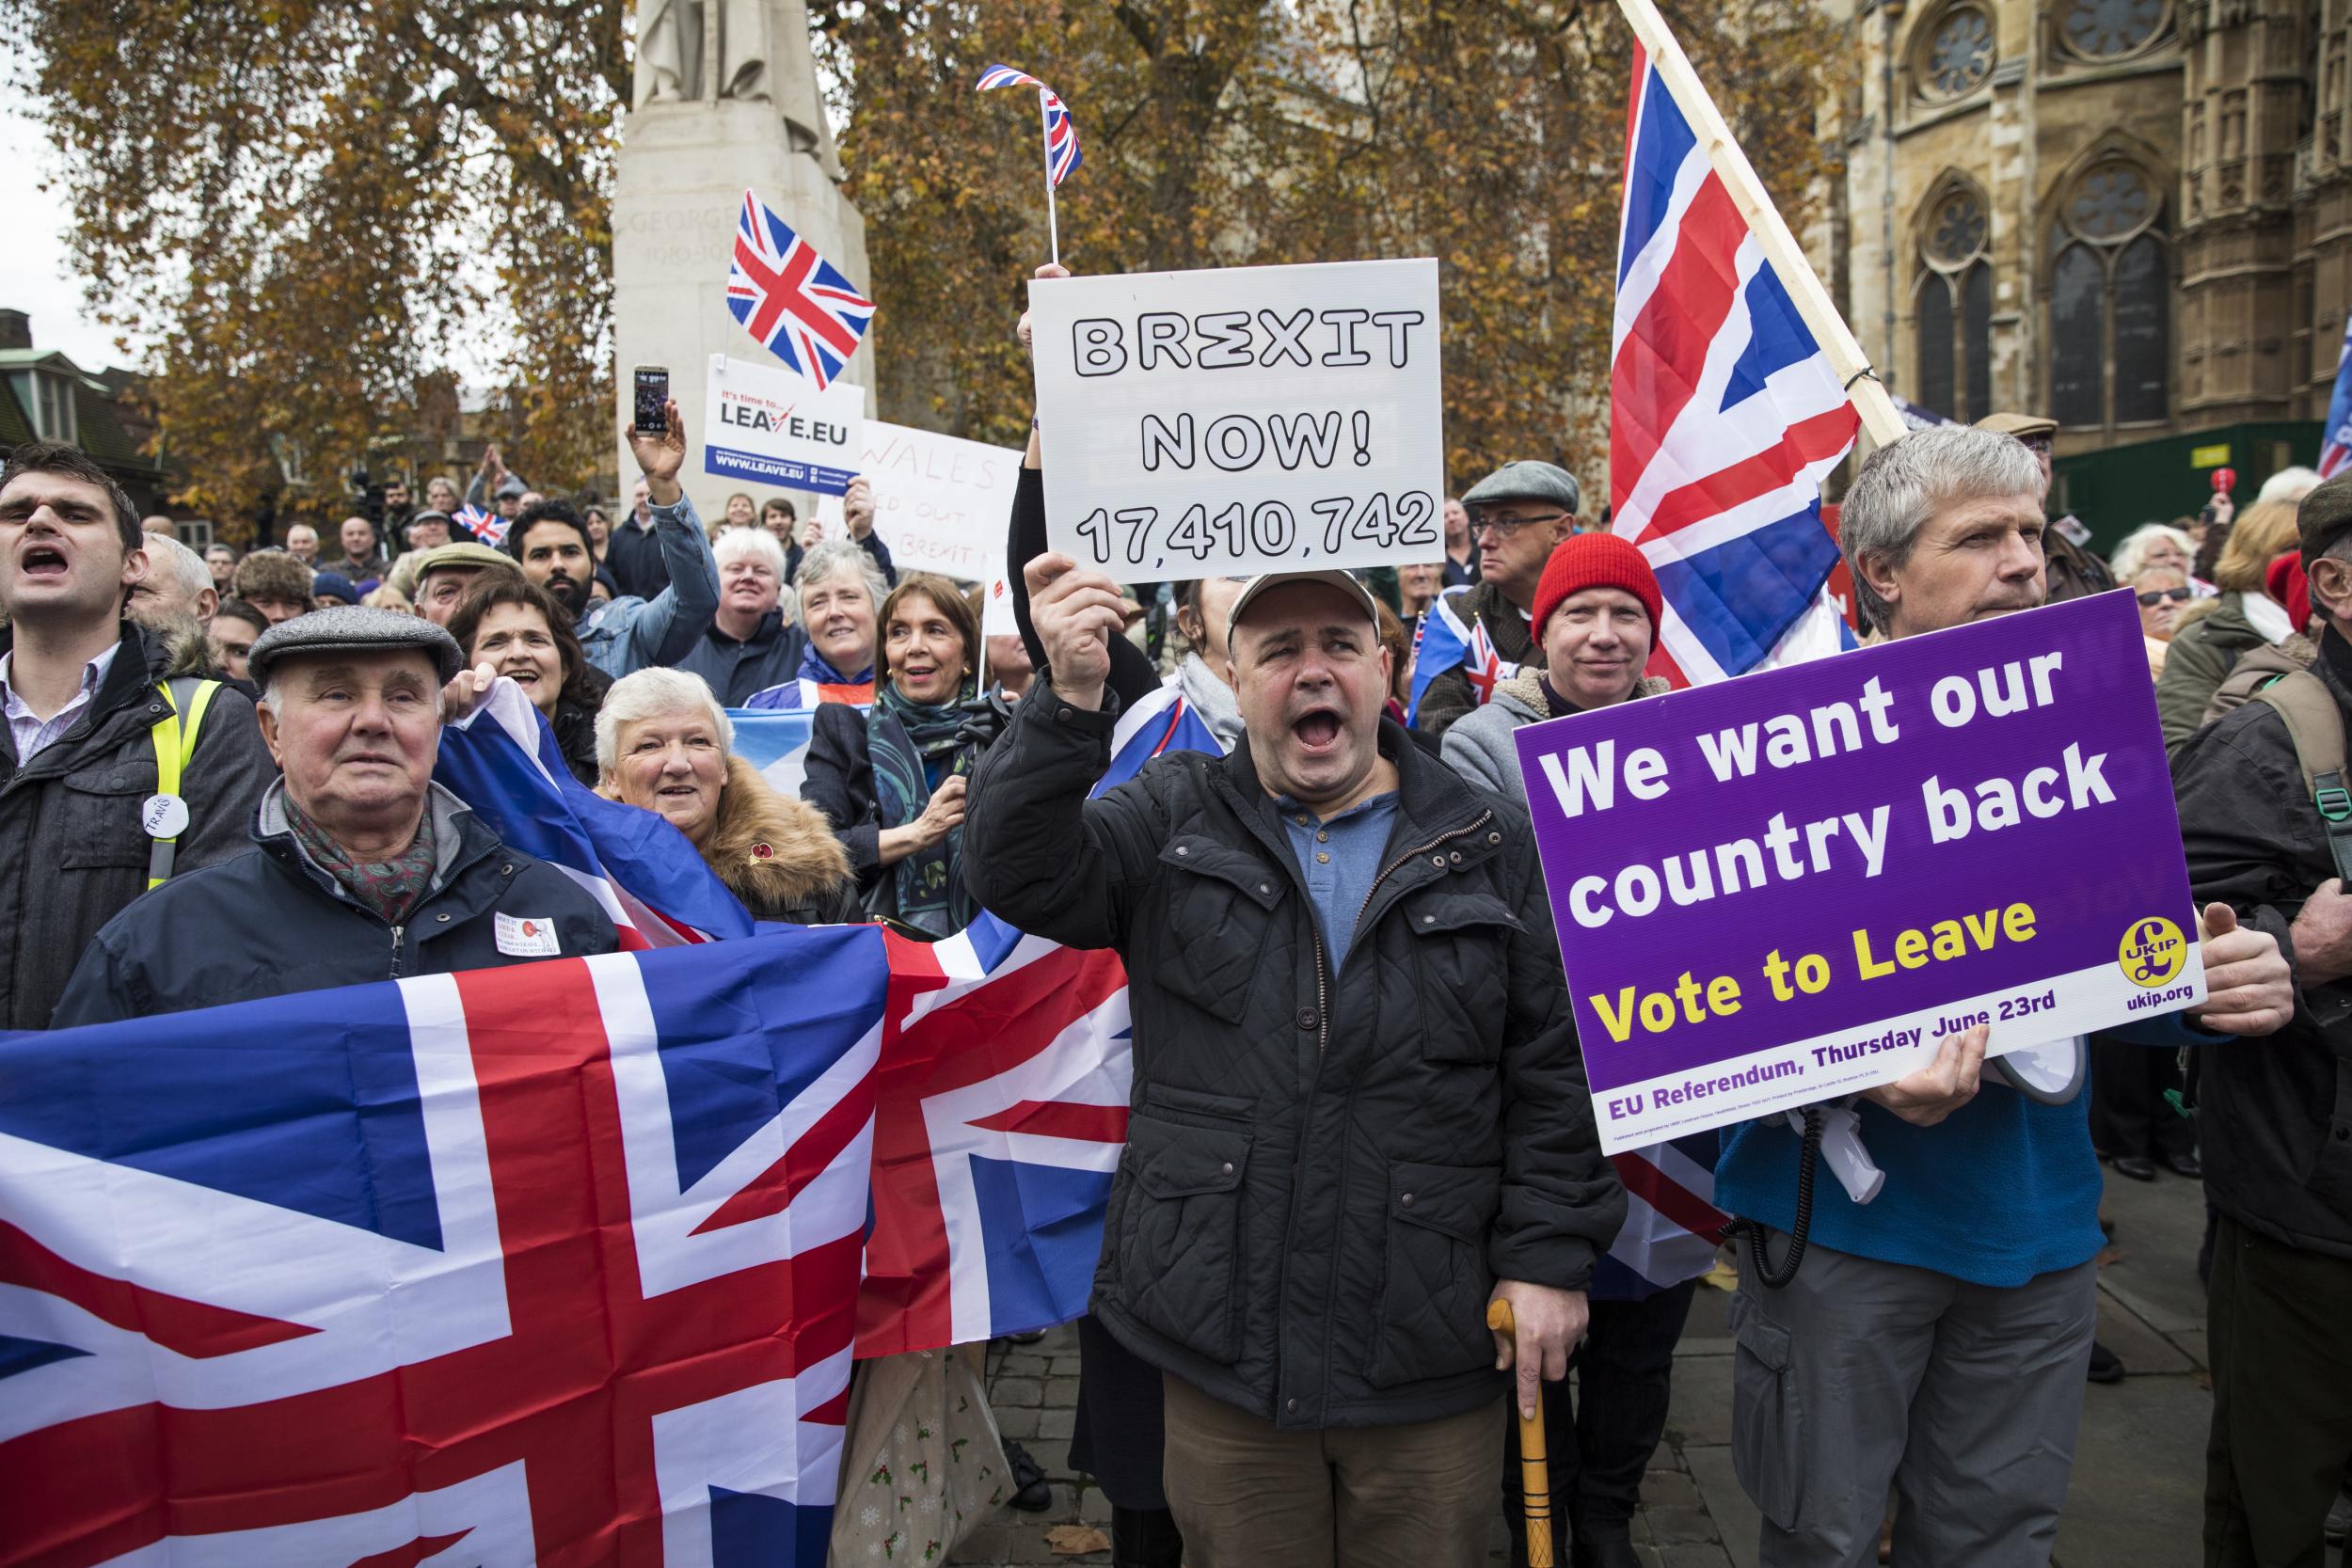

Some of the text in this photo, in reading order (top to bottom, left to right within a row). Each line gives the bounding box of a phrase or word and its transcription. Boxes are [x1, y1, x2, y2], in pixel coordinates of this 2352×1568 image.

[1072, 308, 1425, 378] BREXIT
[722, 389, 738, 401] It's
[740, 394, 763, 405] time
[715, 454, 804, 480] WWW.LEAVE.EU
[860, 437, 996, 490] WALES
[1140, 409, 1372, 472] NOW!
[1075, 490, 1438, 569] 17,410,742
[1538, 650, 2064, 819] We want our
[1567, 740, 2118, 928] country back
[1589, 902, 2038, 1043] Vote to Leave
[2125, 938, 2178, 959] UKIP
[2126, 985, 2194, 1011] ukip.org
[1608, 1093, 1645, 1121] EU
[1652, 1058, 1805, 1110] Referendum,
[1811, 1027, 1922, 1069] Thursday
[1931, 1009, 1991, 1037] June
[1997, 989, 2057, 1022] 23rd
